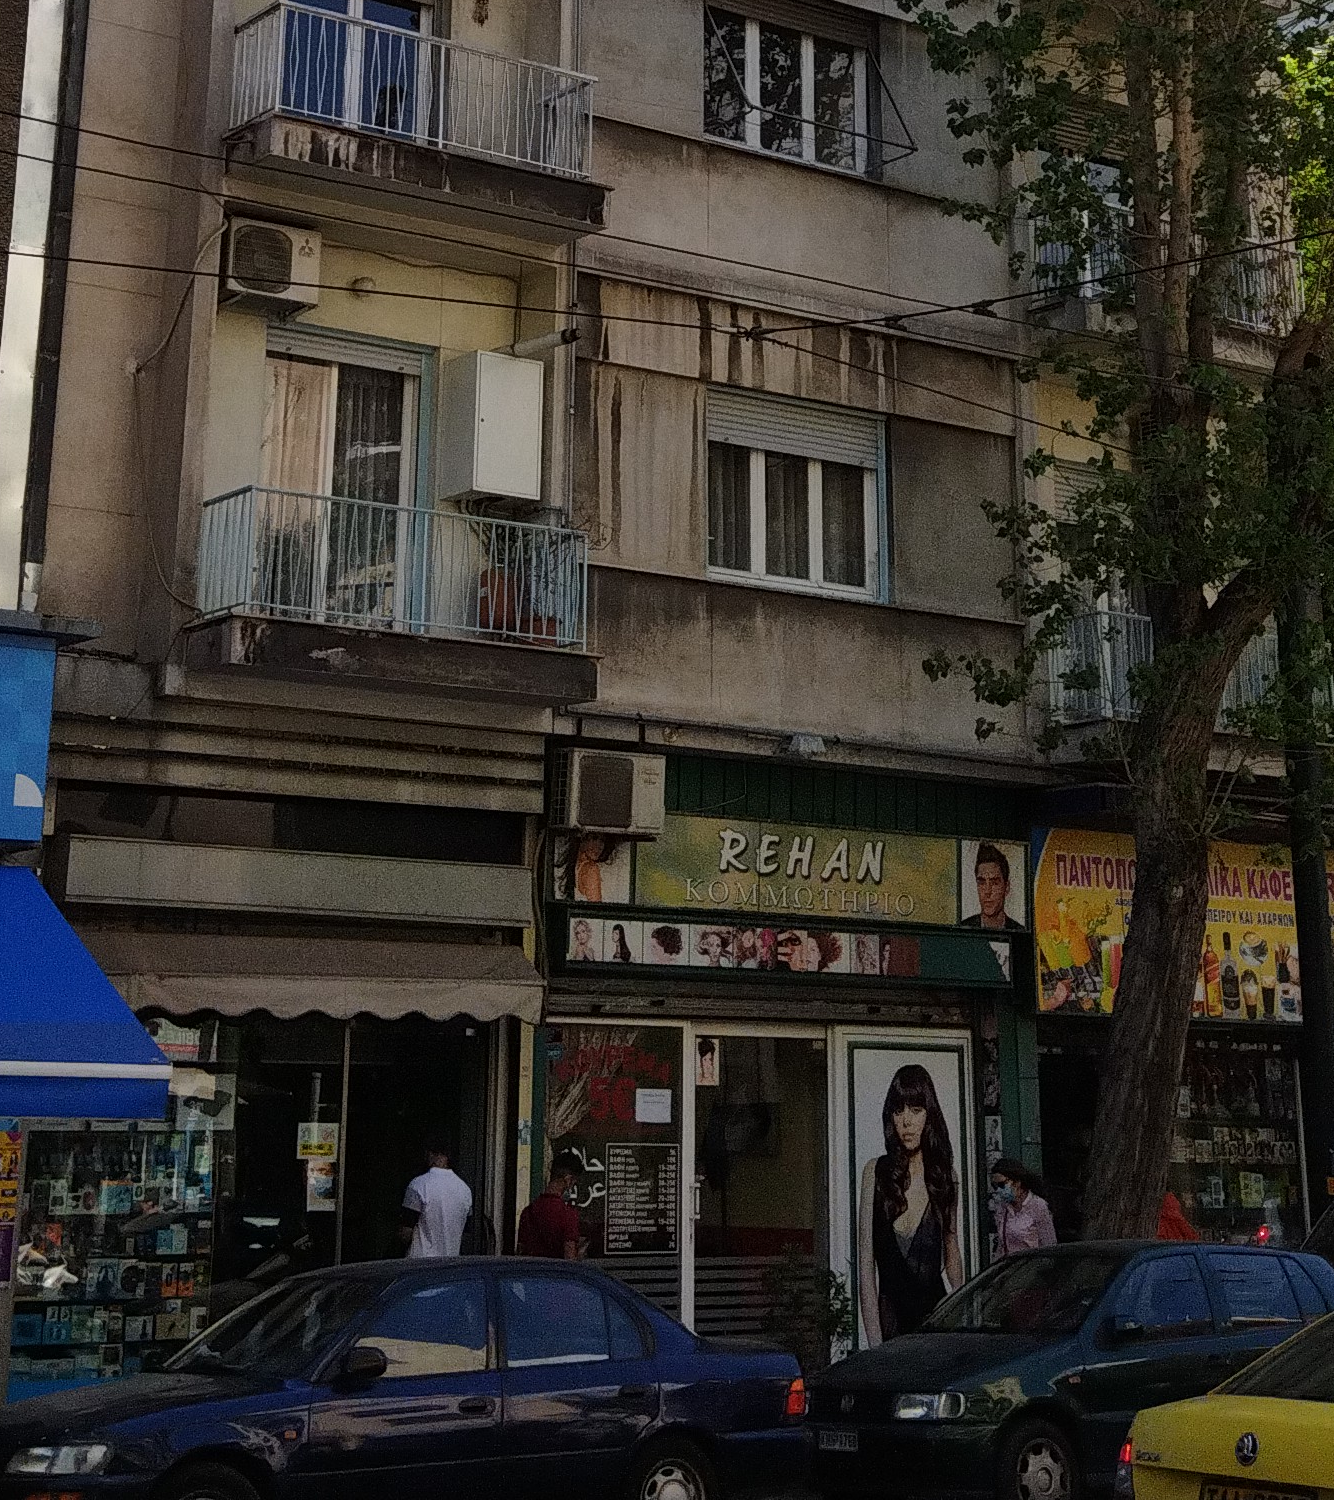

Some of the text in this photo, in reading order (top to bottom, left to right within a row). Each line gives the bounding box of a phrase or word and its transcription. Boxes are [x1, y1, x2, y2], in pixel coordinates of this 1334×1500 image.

[719, 827, 885, 883] REHAN
[684, 877, 915, 918] ΚΟΜΜΩΤΗΡΙΟ
[1245, 867, 1293, 901] ΚΑΦΕ
[1238, 910, 1253, 925] ΚΑΙ
